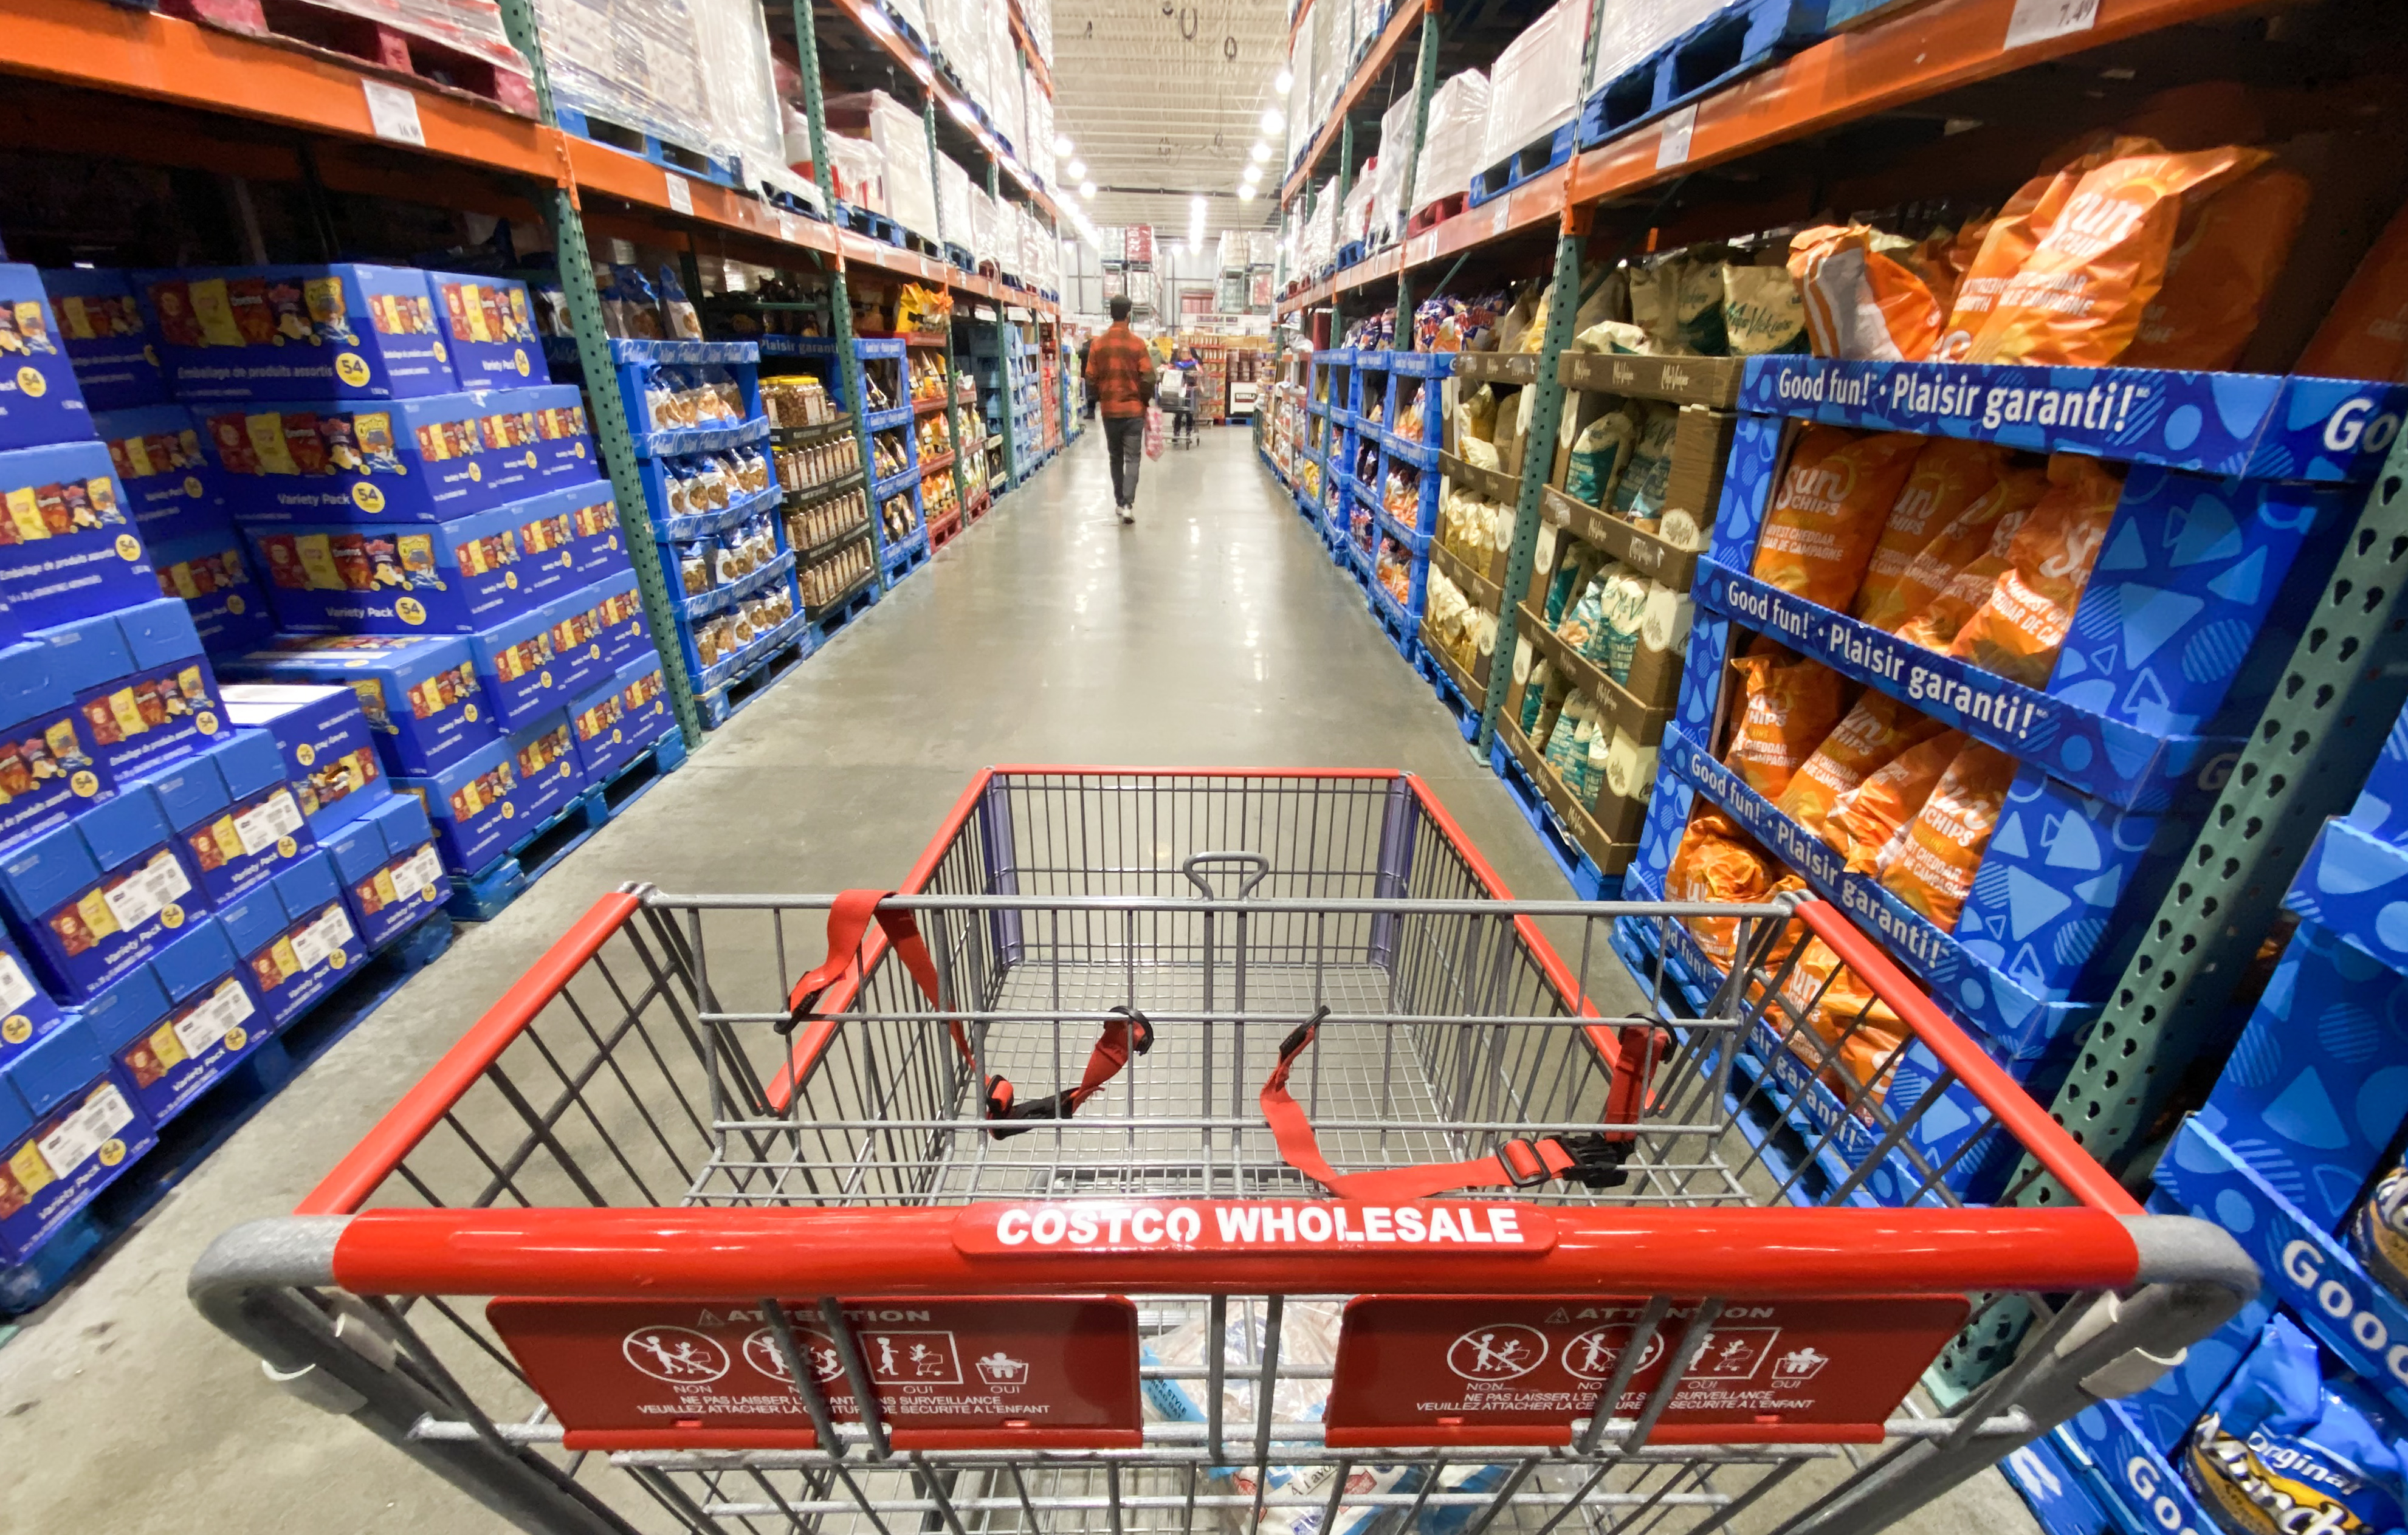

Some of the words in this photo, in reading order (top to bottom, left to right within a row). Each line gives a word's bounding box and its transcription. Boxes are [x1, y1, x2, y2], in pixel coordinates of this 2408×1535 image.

[799, 342, 837, 355] garant
[341, 360, 364, 374] 54
[1780, 368, 1823, 402] Good
[1829, 368, 1870, 406] fun!
[1893, 373, 1980, 417] Plaisir
[1983, 383, 2133, 433] garanti!
[357, 488, 379, 502] 54
[1776, 465, 1848, 511] Sun
[277, 492, 320, 507] Variety
[322, 492, 351, 505] Pack
[1792, 495, 1841, 517] CHIPS
[1789, 527, 1836, 546] CHEDDAR
[1789, 540, 1844, 561] CAMPAGNE
[367, 606, 394, 619] Pack
[401, 602, 421, 615] 54
[1729, 580, 1768, 622] Good
[1772, 601, 1809, 639] fun!
[1829, 624, 1904, 682] Plaisir
[1908, 664, 2036, 740] garanti!
[75, 774, 94, 789] 54
[1924, 806, 1975, 847] CHIPS
[1691, 753, 1727, 799] Good
[1730, 781, 1762, 825] fun!
[1777, 821, 1838, 885] Plaisir
[1841, 878, 1939, 967] garanti!
[1916, 846, 1963, 881] CHEDDAR
[104, 939, 139, 965] Variety
[139, 923, 162, 942] Pack
[6, 1020, 26, 1035] 54
[103, 1142, 120, 1159] 54
[38, 1185, 75, 1220] Variety
[75, 1163, 102, 1188] Pack
[996, 1207, 1201, 1246] COSTCO
[1216, 1206, 1524, 1243] WHOLESALE
[728, 1310, 930, 1322] ATETION
[673, 1386, 712, 1394] NON
[903, 1386, 934, 1394] OUI
[989, 1386, 1021, 1394] OUI
[1688, 1381, 1717, 1389] OUI
[1771, 1380, 1801, 1389] OUI
[1168, 1389, 1187, 1416] STYLE
[1464, 1393, 1484, 1402] NE
[1485, 1393, 1511, 1401] PAS
[1513, 1392, 1570, 1401] LAISSER
[1675, 1390, 1775, 1400] SURVEILLANCE
[637, 1405, 707, 1414] VEUILLEZ
[708, 1405, 781, 1414] ATTACHER
[783, 1405, 802, 1413] LA
[1416, 1403, 1481, 1411] VEUILLEZ
[1481, 1402, 1553, 1410] ATTACHER
[1555, 1402, 1573, 1410] LA
[1575, 1401, 1642, 1410] CEURE
[1749, 1399, 1816, 1409] L'ENFANT
[2127, 1457, 2200, 1535] Go
